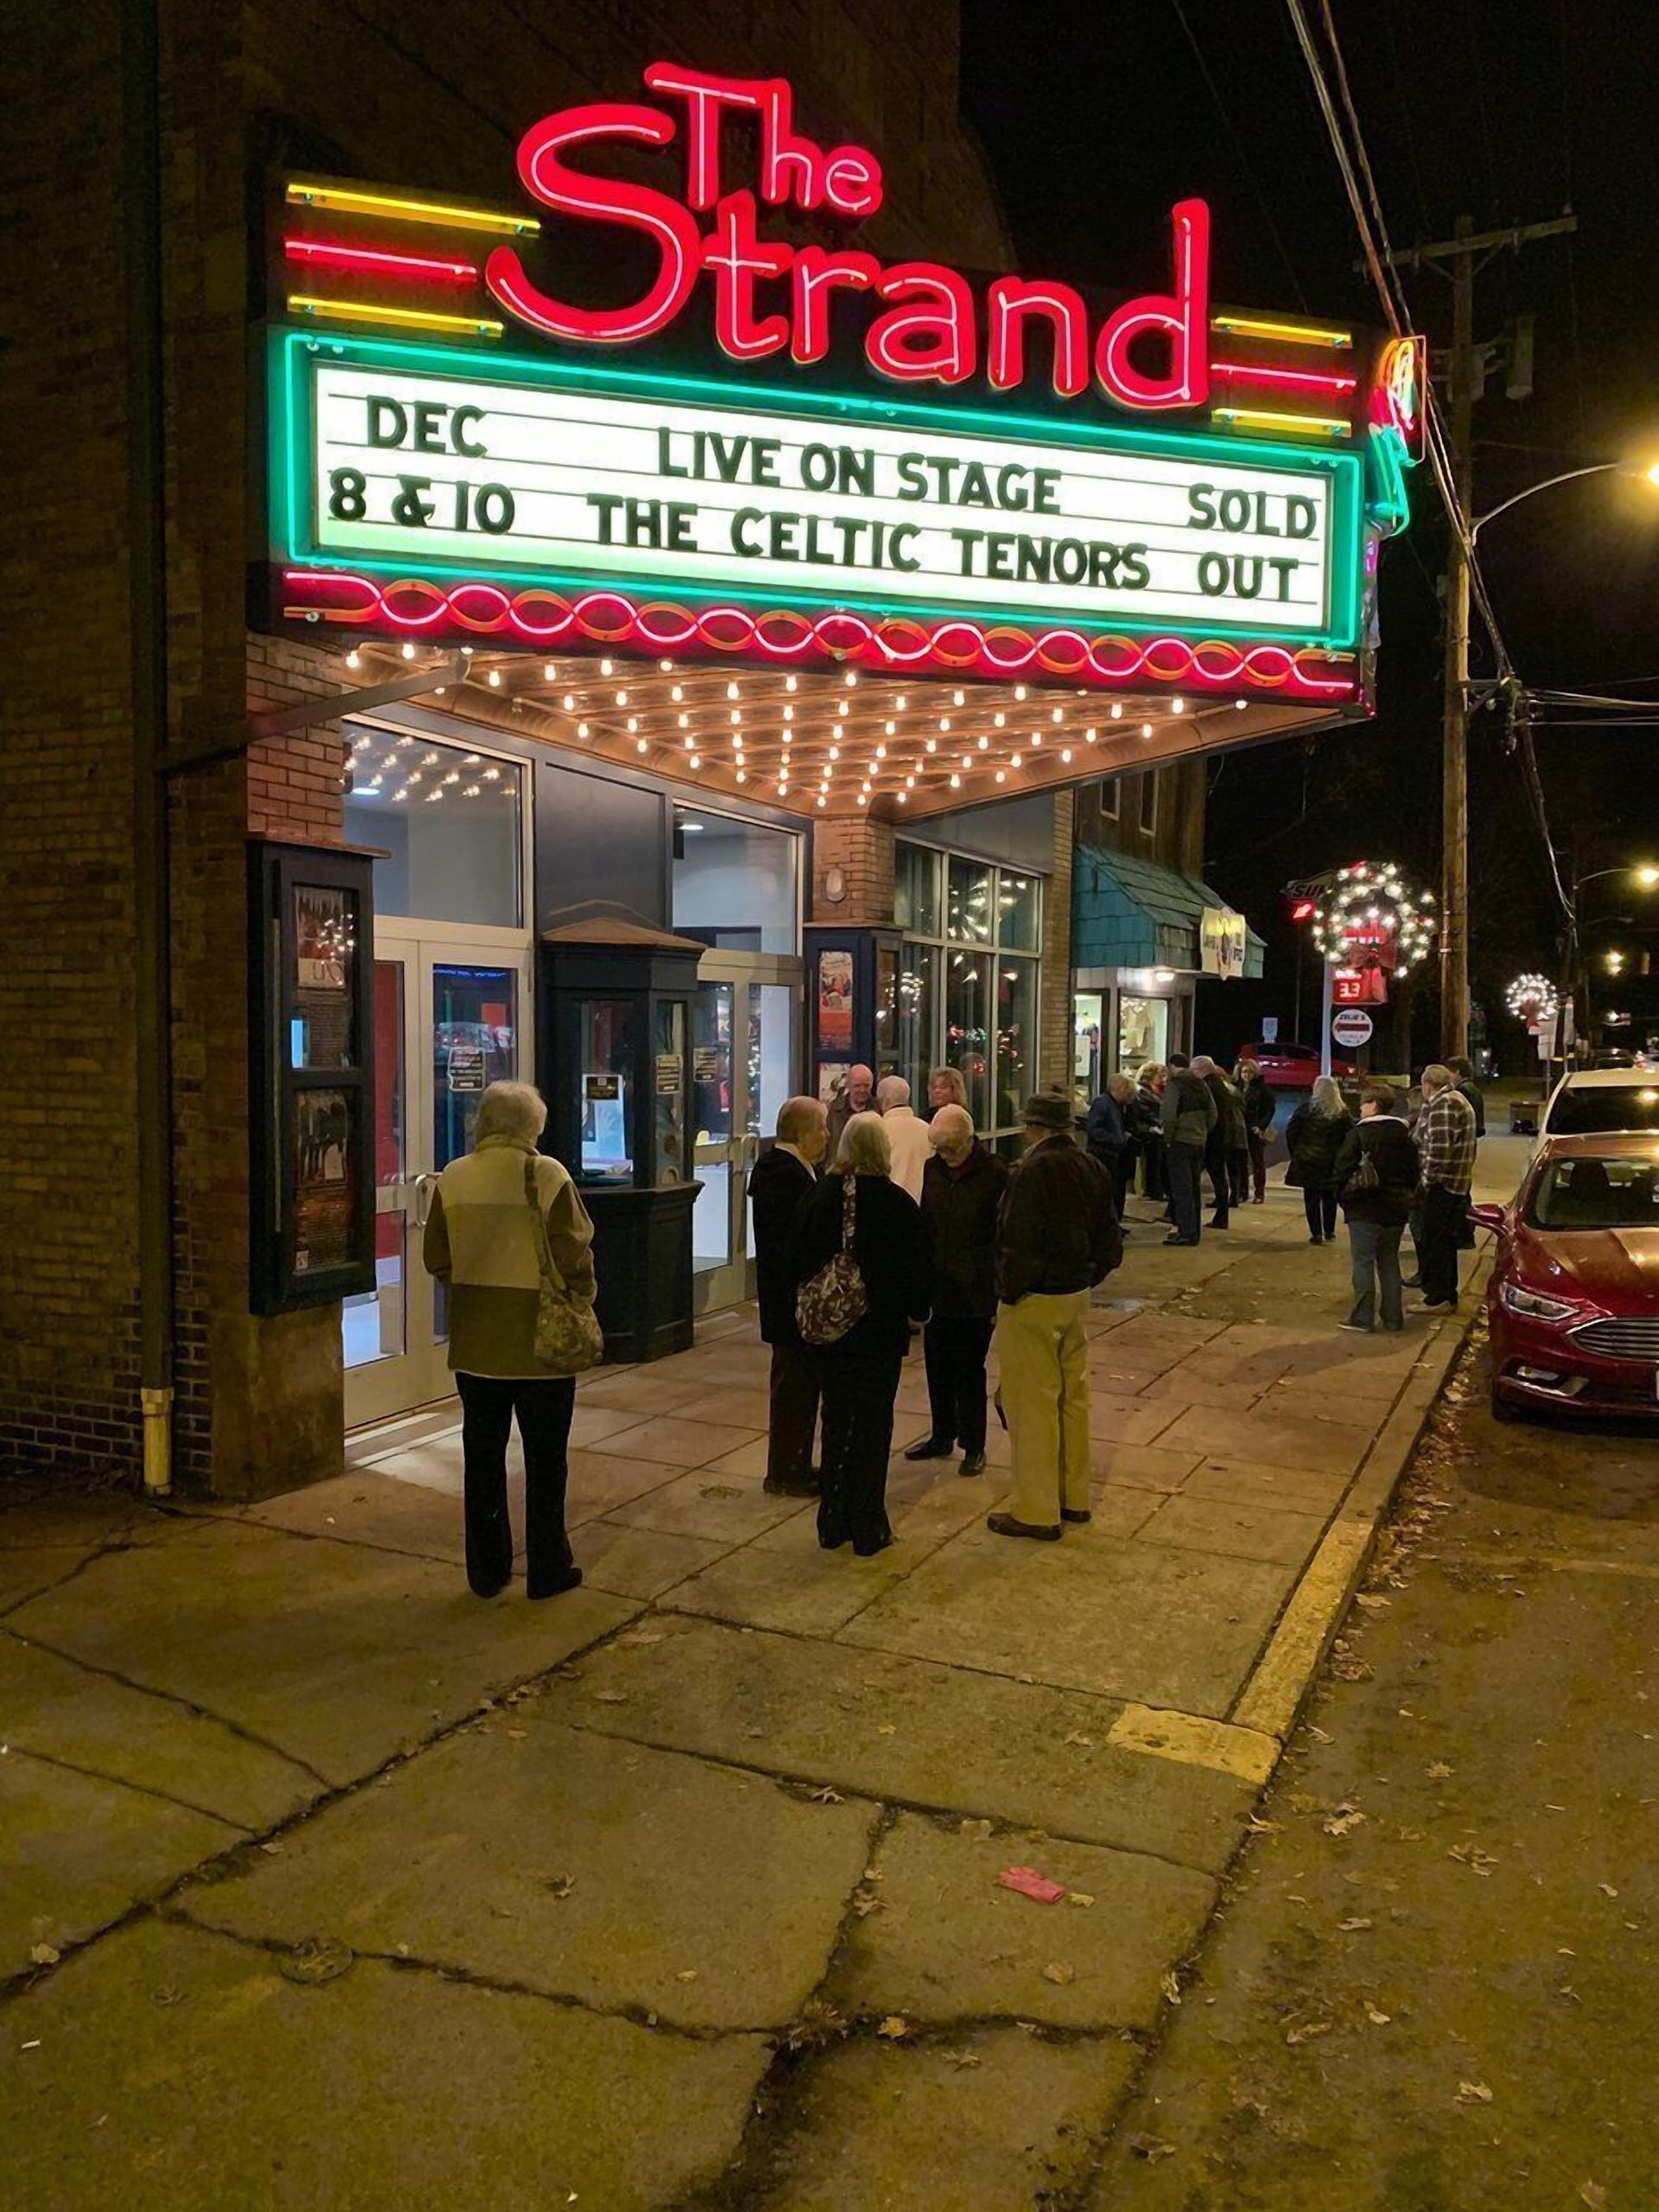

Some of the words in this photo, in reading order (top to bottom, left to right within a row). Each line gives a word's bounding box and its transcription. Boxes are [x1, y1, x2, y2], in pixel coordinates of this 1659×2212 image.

[644, 61, 882, 216] The
[486, 103, 1210, 409] Strand
[367, 395, 488, 457] DEC
[329, 467, 366, 521] 8
[391, 474, 435, 527] &
[455, 480, 515, 535] 10
[658, 427, 781, 487] LIVE
[800, 443, 874, 497] ON
[898, 453, 1061, 515] STAGE
[587, 493, 697, 552] THE
[731, 507, 921, 571] CELTIC
[951, 528, 1150, 590] TENORS
[1188, 483, 1316, 539] SOLD
[1198, 552, 1298, 602] OUT
